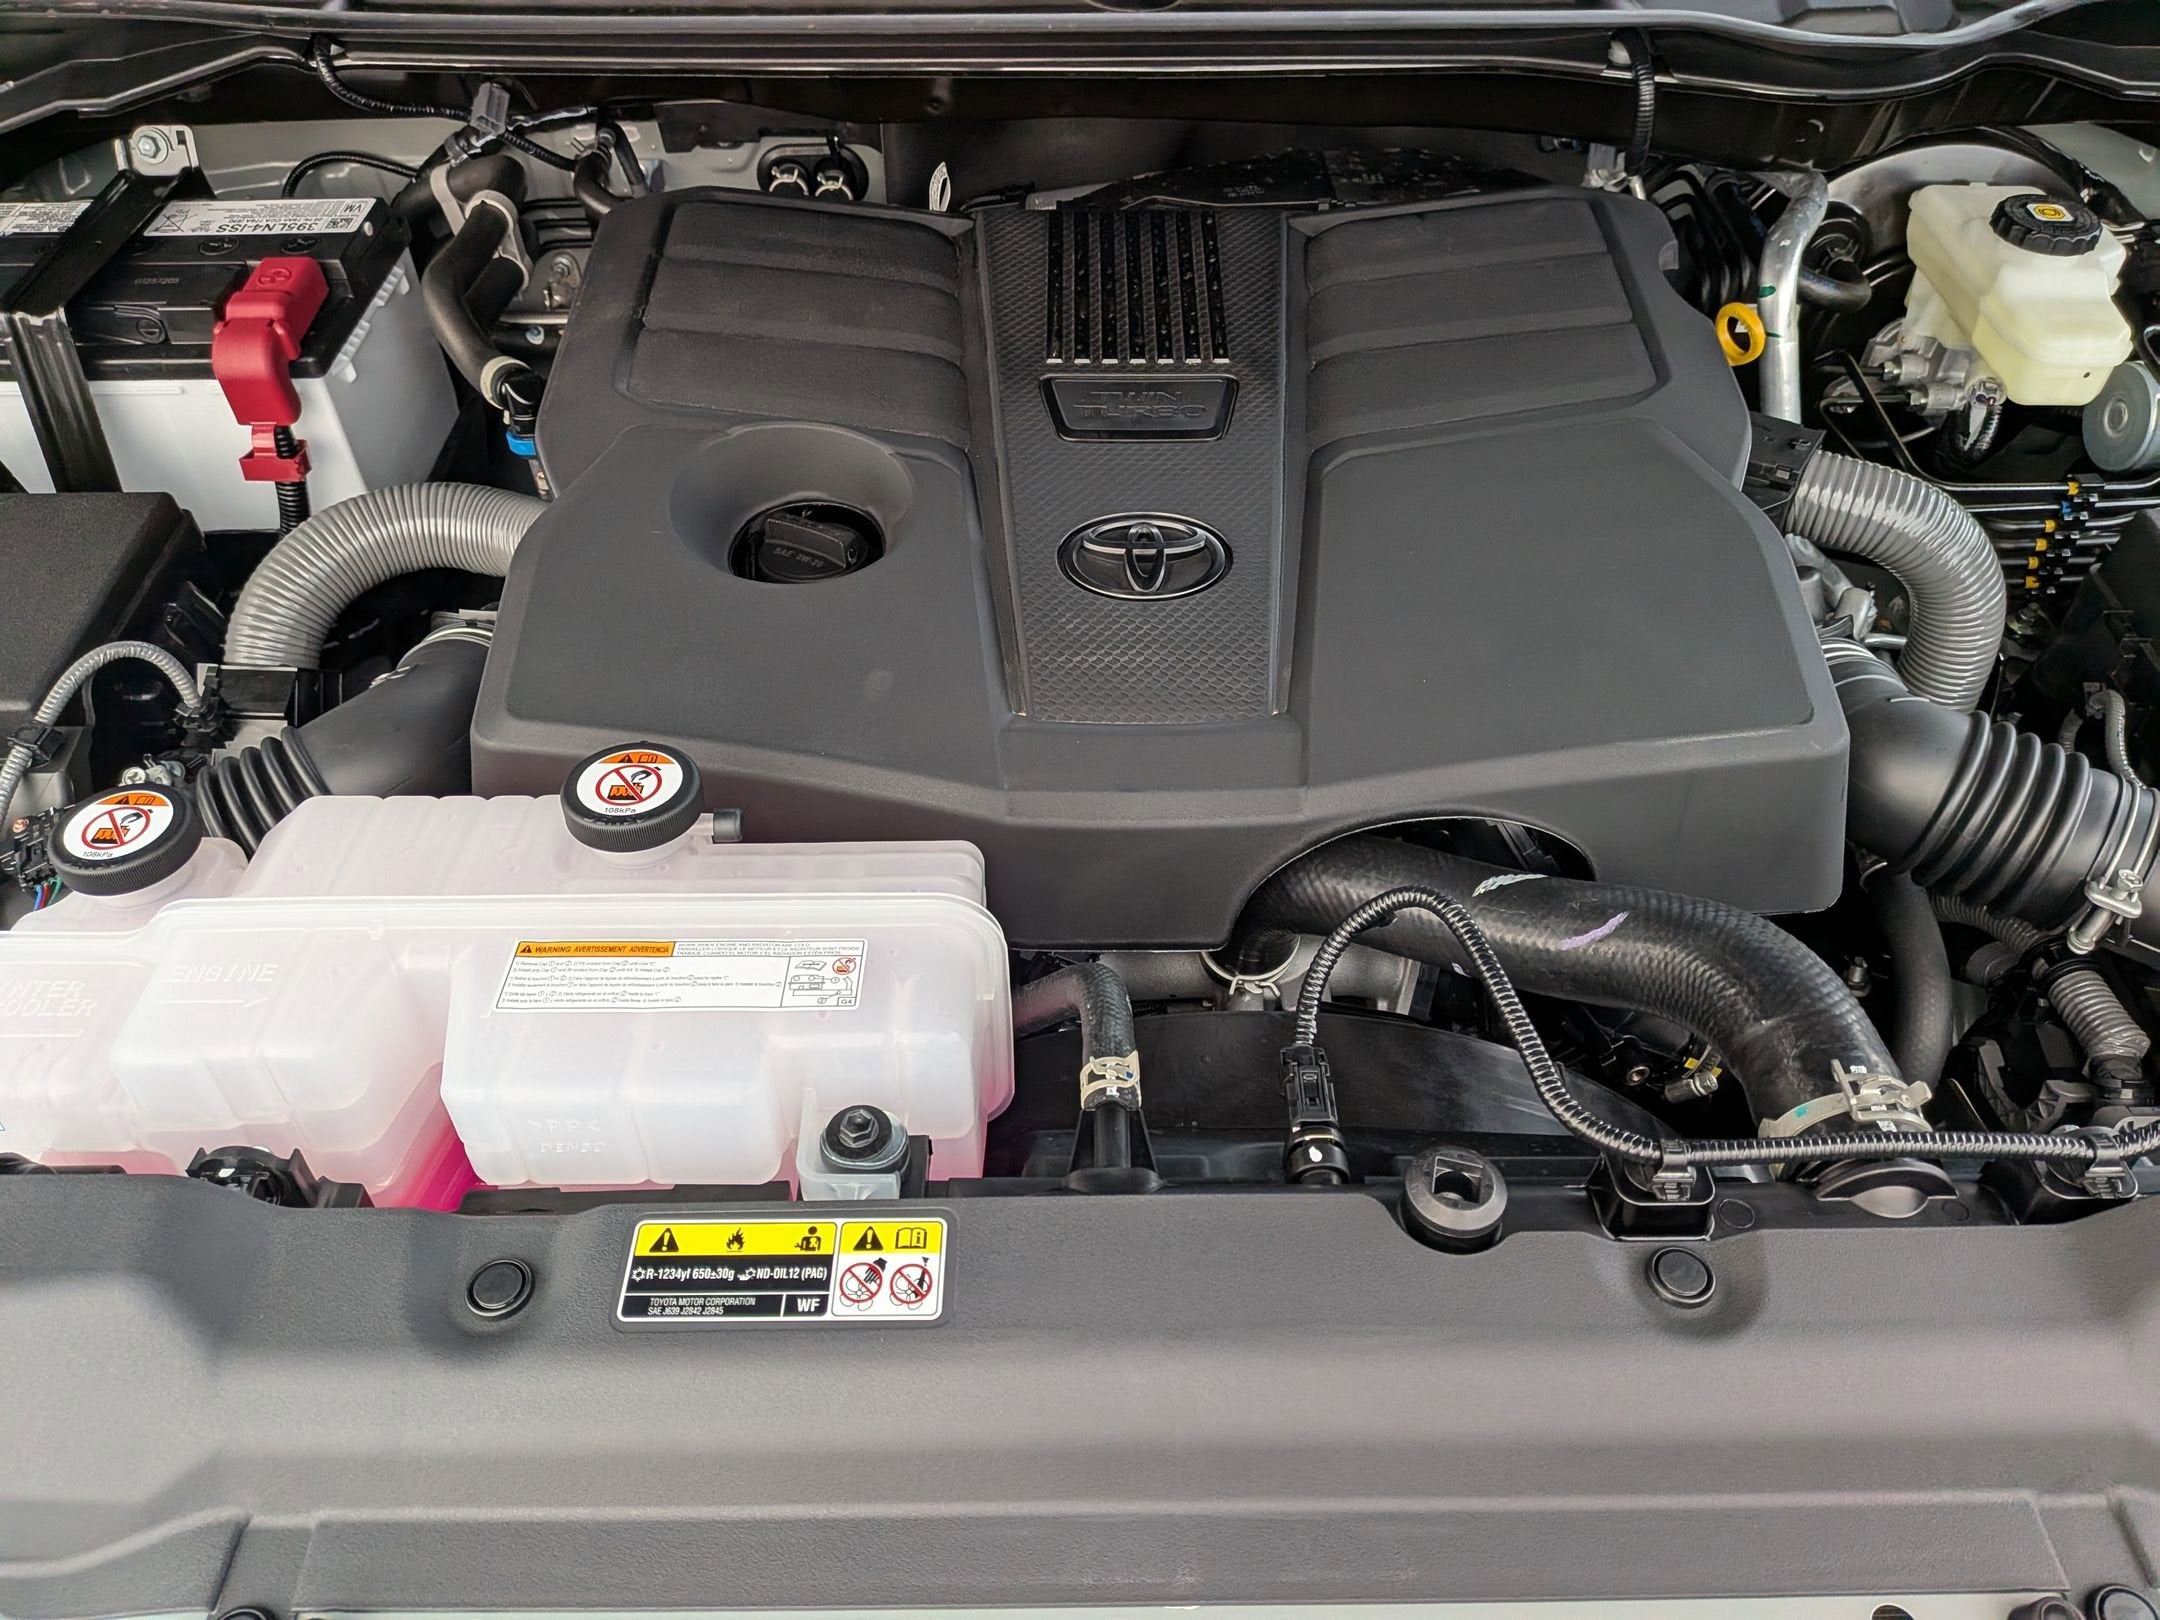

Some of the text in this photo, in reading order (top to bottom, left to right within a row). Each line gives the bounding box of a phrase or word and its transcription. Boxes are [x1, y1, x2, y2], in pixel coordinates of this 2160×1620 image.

[344, 203, 362, 213] VM
[216, 223, 319, 233] 395LN4-ISS
[1073, 404, 1208, 418] TURBO
[163, 963, 279, 982] ENGINE
[646, 1268, 690, 1281] R-1234yf
[692, 1267, 735, 1281] 650±30g
[801, 1267, 828, 1281] (PAG)
[650, 1297, 756, 1306] TOYOTA MOTOR CORPORATION
[797, 1298, 820, 1312] WF
[648, 1307, 724, 1315] SAE J639 J2842 J2845
